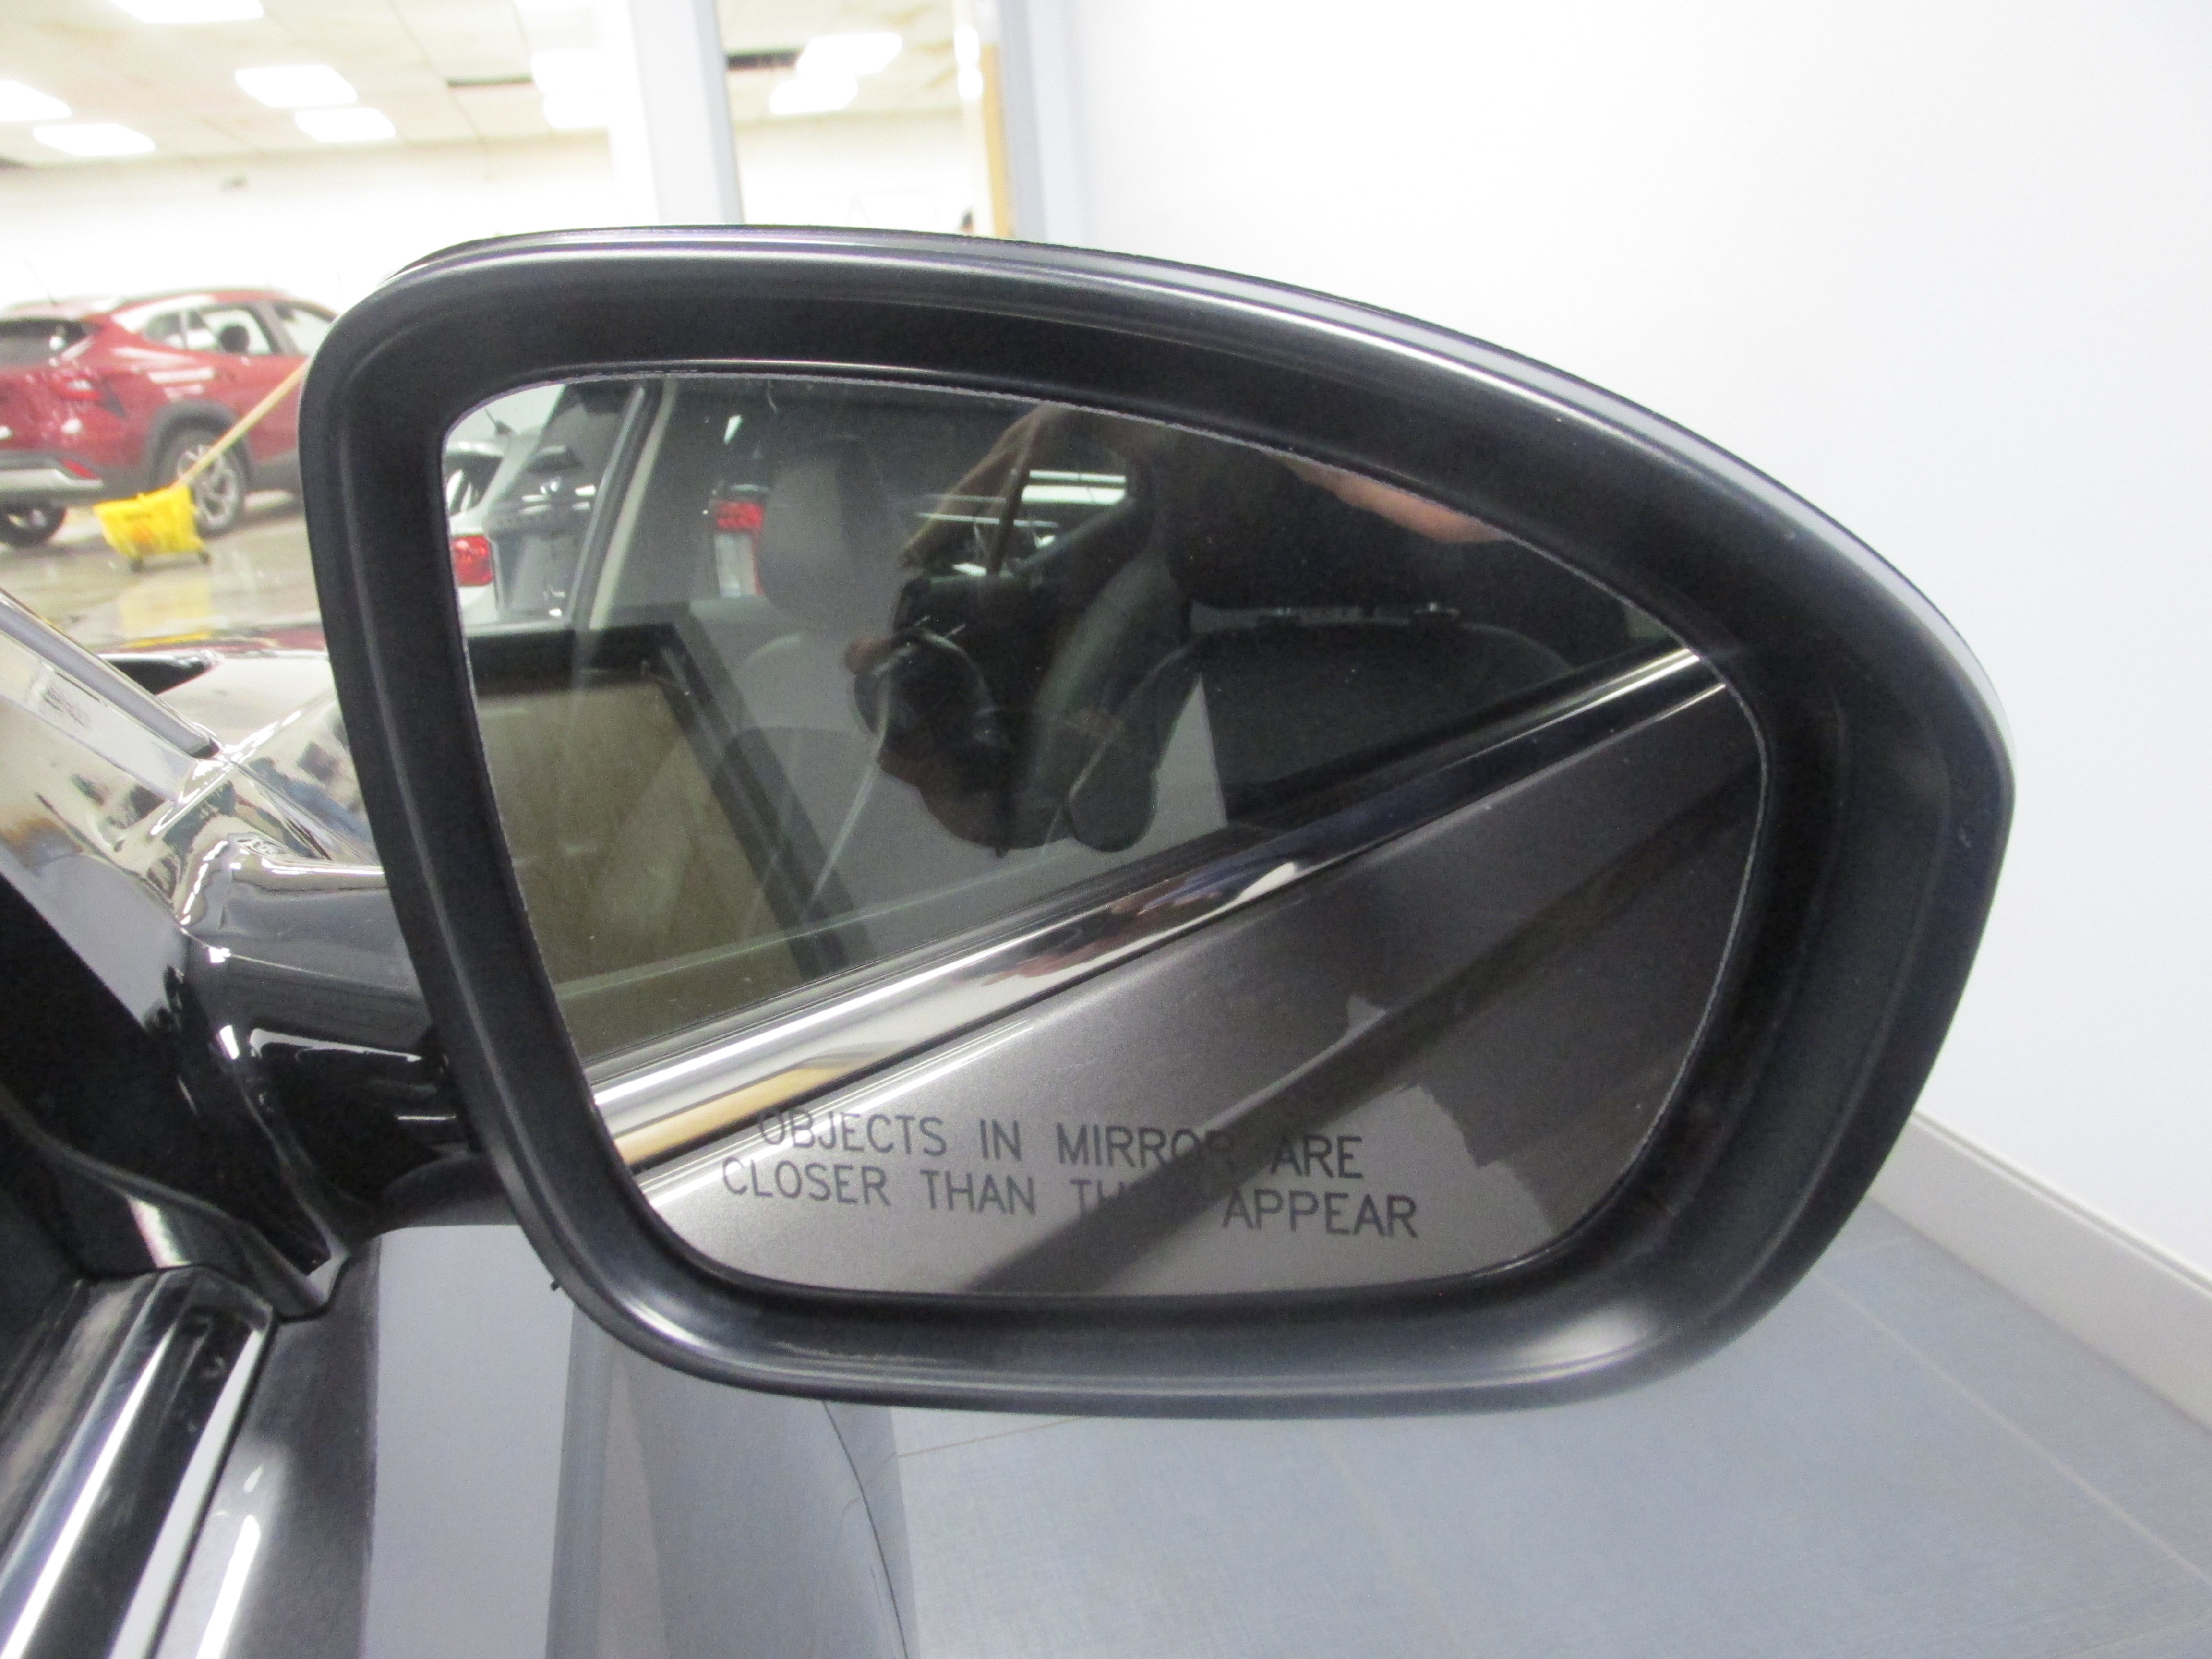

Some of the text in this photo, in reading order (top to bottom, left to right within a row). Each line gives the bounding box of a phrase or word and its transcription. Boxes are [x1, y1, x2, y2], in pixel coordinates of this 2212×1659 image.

[758, 1106, 947, 1157] OBJECTS
[980, 1118, 1022, 1162] IN
[1270, 1133, 1363, 1179] ARE
[722, 1156, 891, 1206] CLOSER
[920, 1168, 1036, 1216] THAN
[1222, 1188, 1419, 1238] APPEAR
